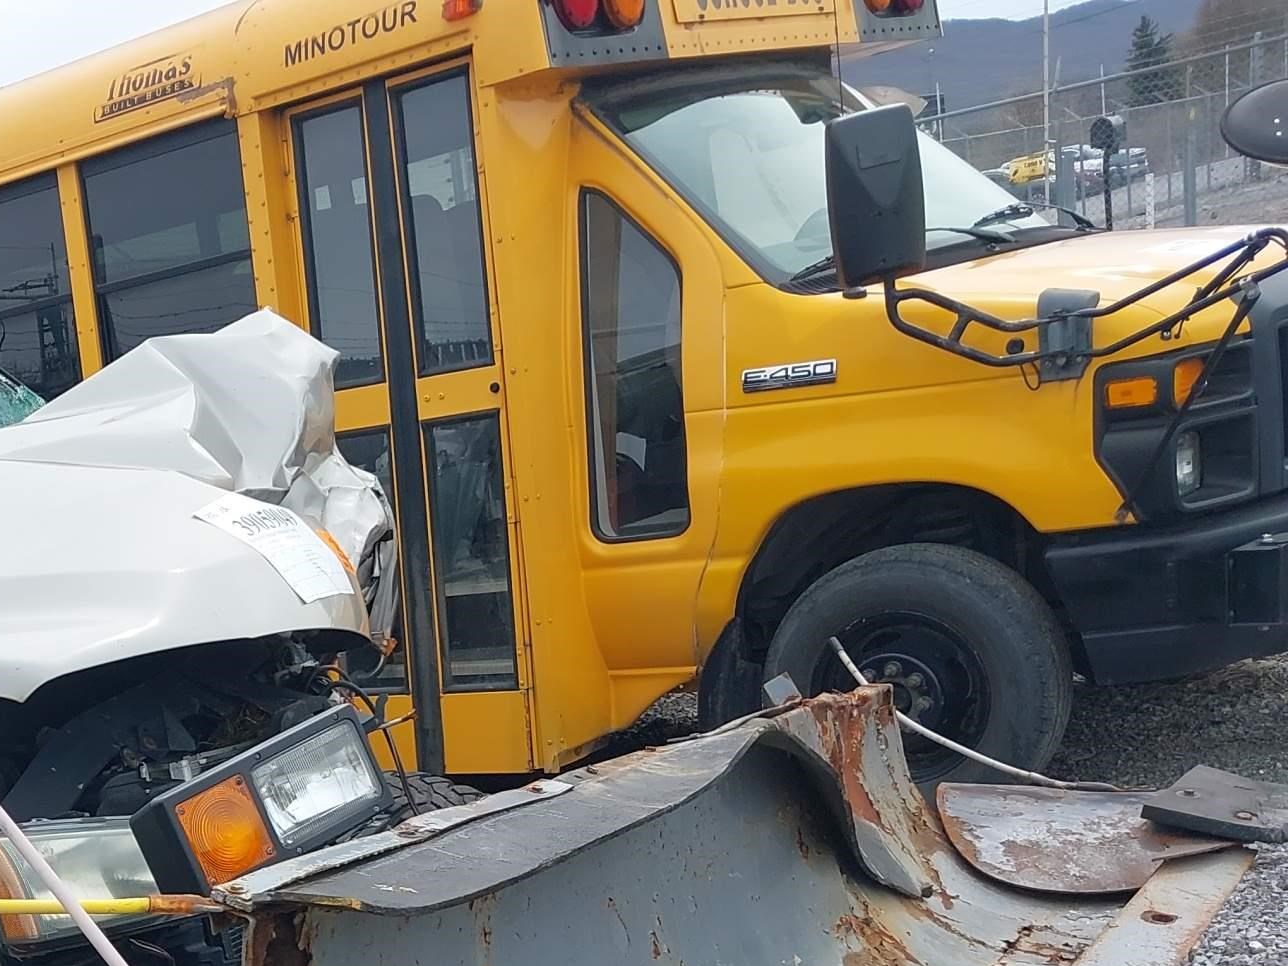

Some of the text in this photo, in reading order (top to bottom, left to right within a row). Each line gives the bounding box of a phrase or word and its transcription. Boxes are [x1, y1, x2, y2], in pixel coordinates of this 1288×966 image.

[284, 1, 417, 68] MINOTOUR
[103, 80, 191, 115] BUILT BUSES
